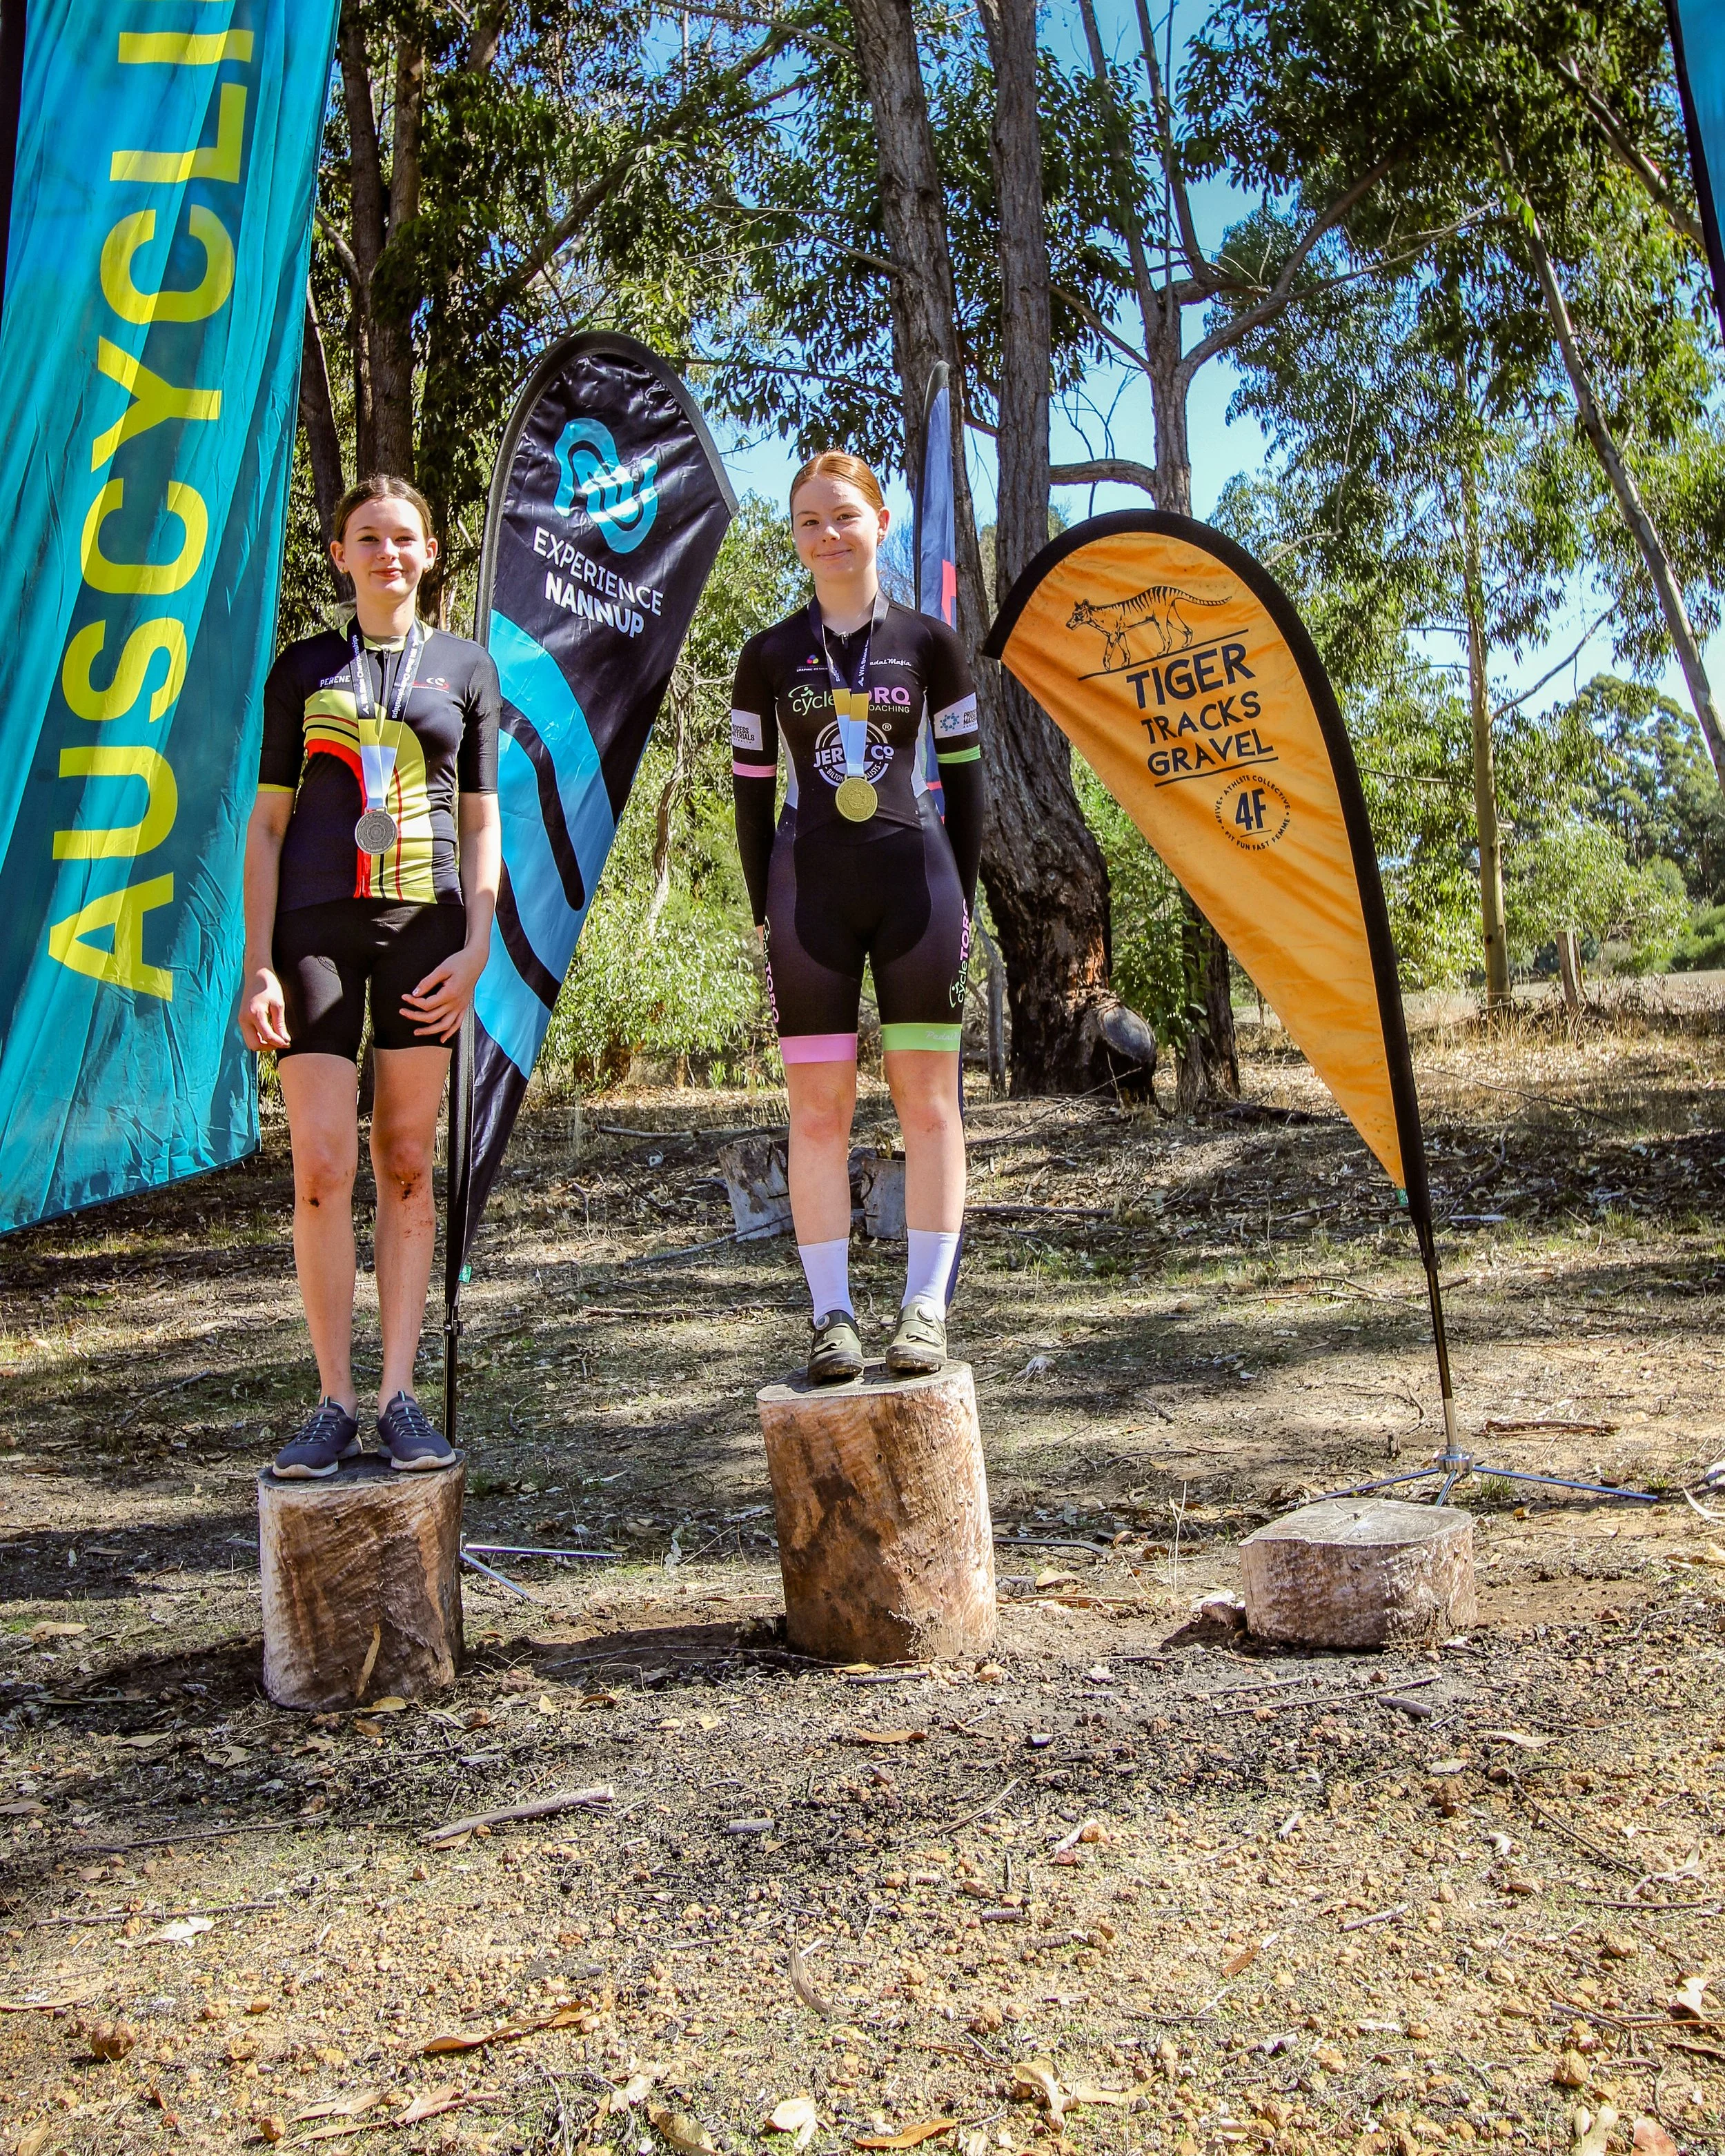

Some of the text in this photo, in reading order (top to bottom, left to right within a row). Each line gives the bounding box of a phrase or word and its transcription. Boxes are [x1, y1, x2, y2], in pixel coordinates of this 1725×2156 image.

[48, 0, 254, 1002] AUSCYCLI
[533, 525, 664, 616] EXPERIENCE
[544, 571, 644, 638] NANNUP
[351, 635, 364, 678] Championships
[1126, 643, 1256, 709] TIGER
[392, 673, 411, 719] Championships
[869, 704, 910, 713] OACHING
[1141, 691, 1261, 744] TRACKS
[1147, 729, 1274, 776] GRAVEL
[1223, 775, 1250, 795] ATHLETE
[1252, 775, 1290, 810] COLLECTIVE
[1235, 787, 1267, 831] 4F
[1225, 818, 1290, 851] FIT FUN FAST FEMME
